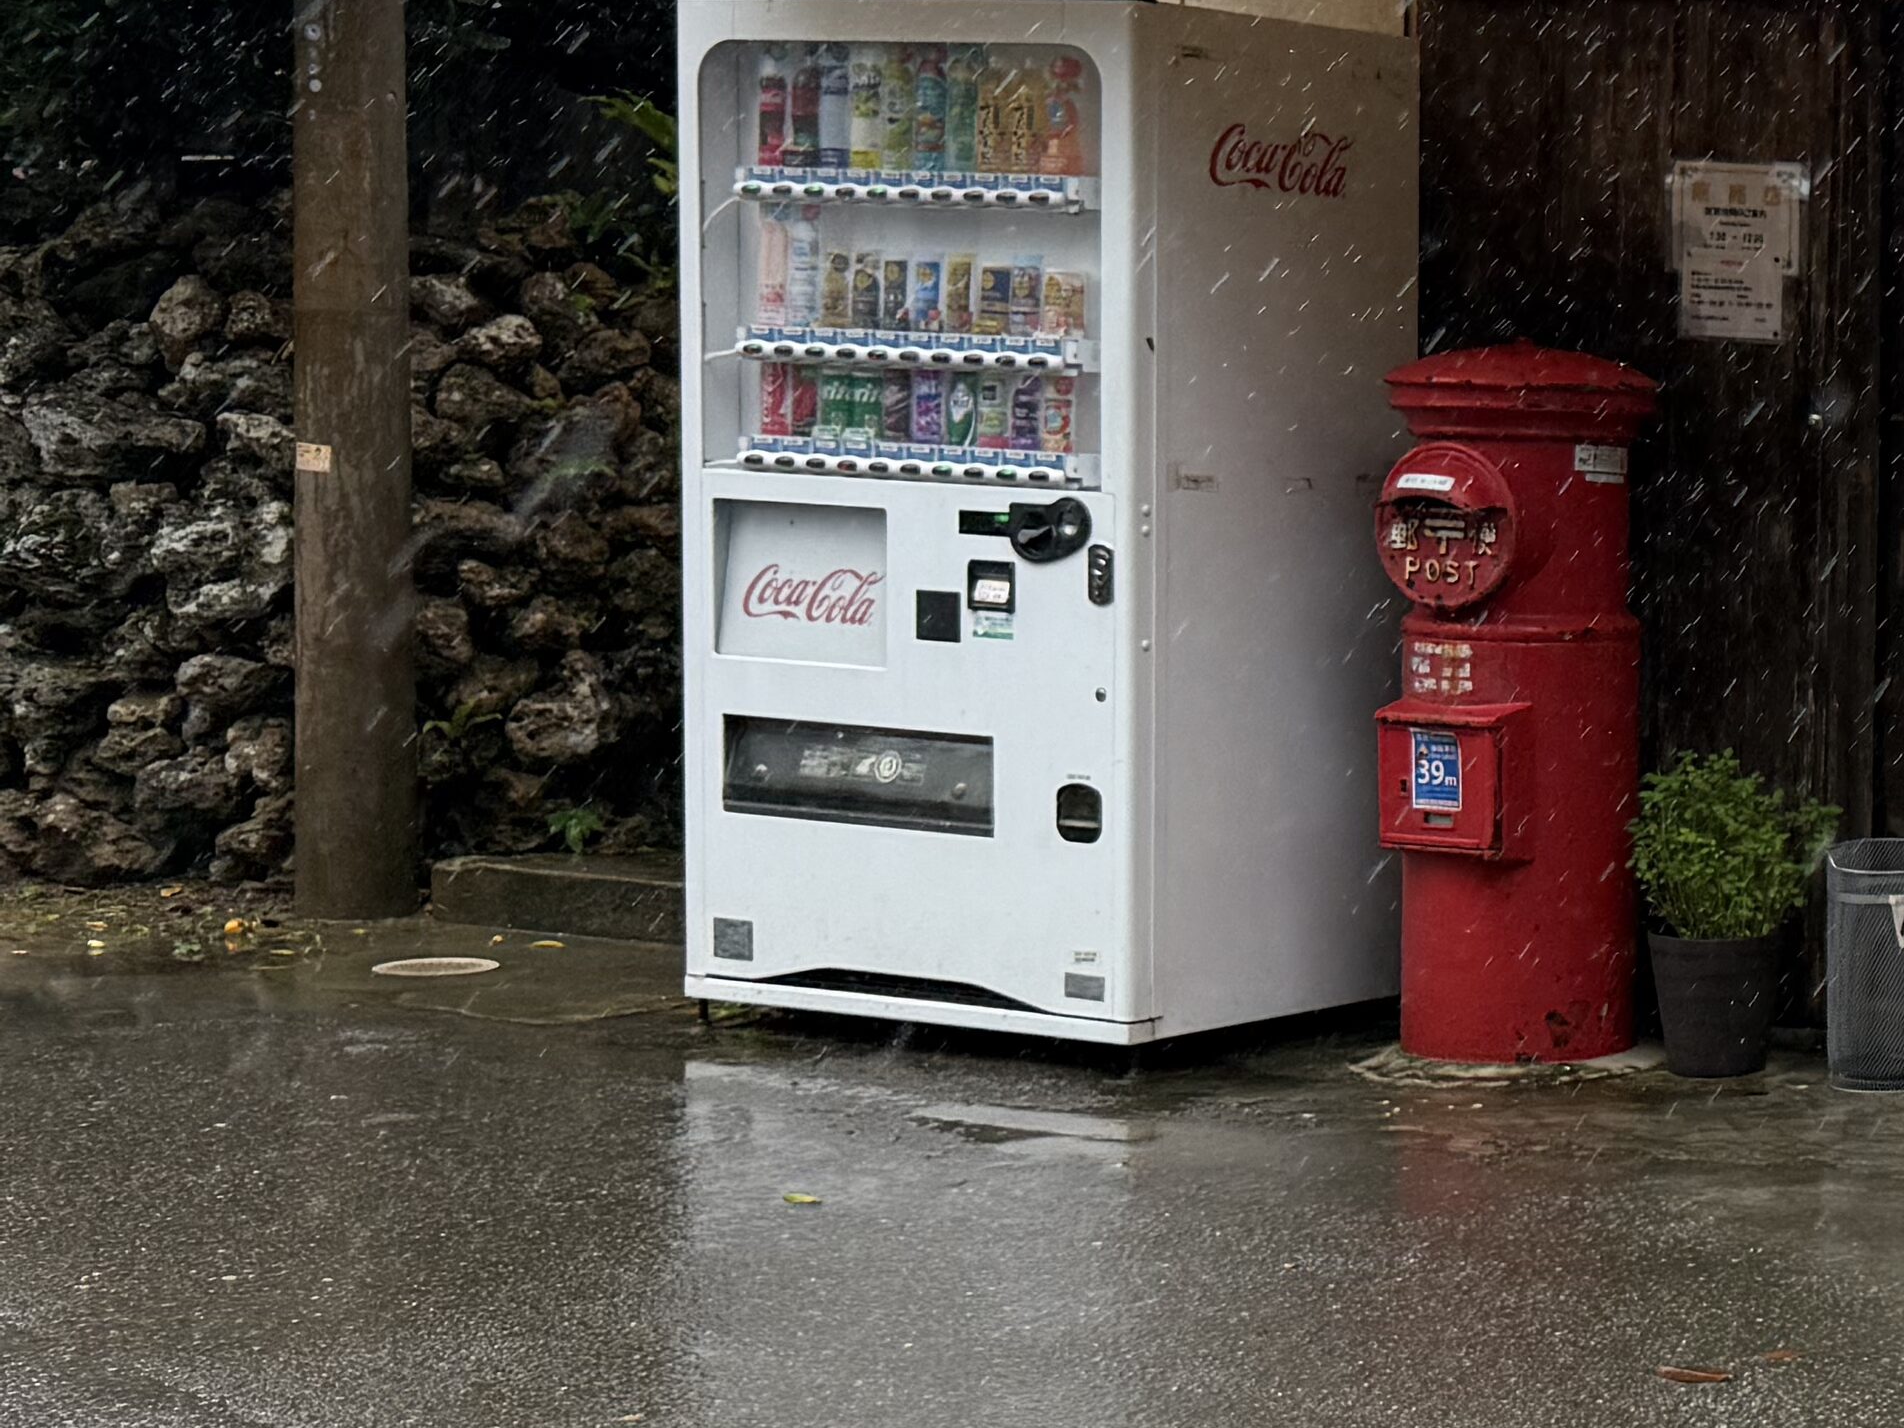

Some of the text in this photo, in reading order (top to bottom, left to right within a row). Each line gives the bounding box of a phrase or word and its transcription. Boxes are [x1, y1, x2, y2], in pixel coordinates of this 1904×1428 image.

[1210, 123, 1354, 198] Coca-Cola
[1405, 556, 1480, 586] POST
[743, 563, 887, 627] Coca-Cola
[1417, 759, 1457, 787] 39m
